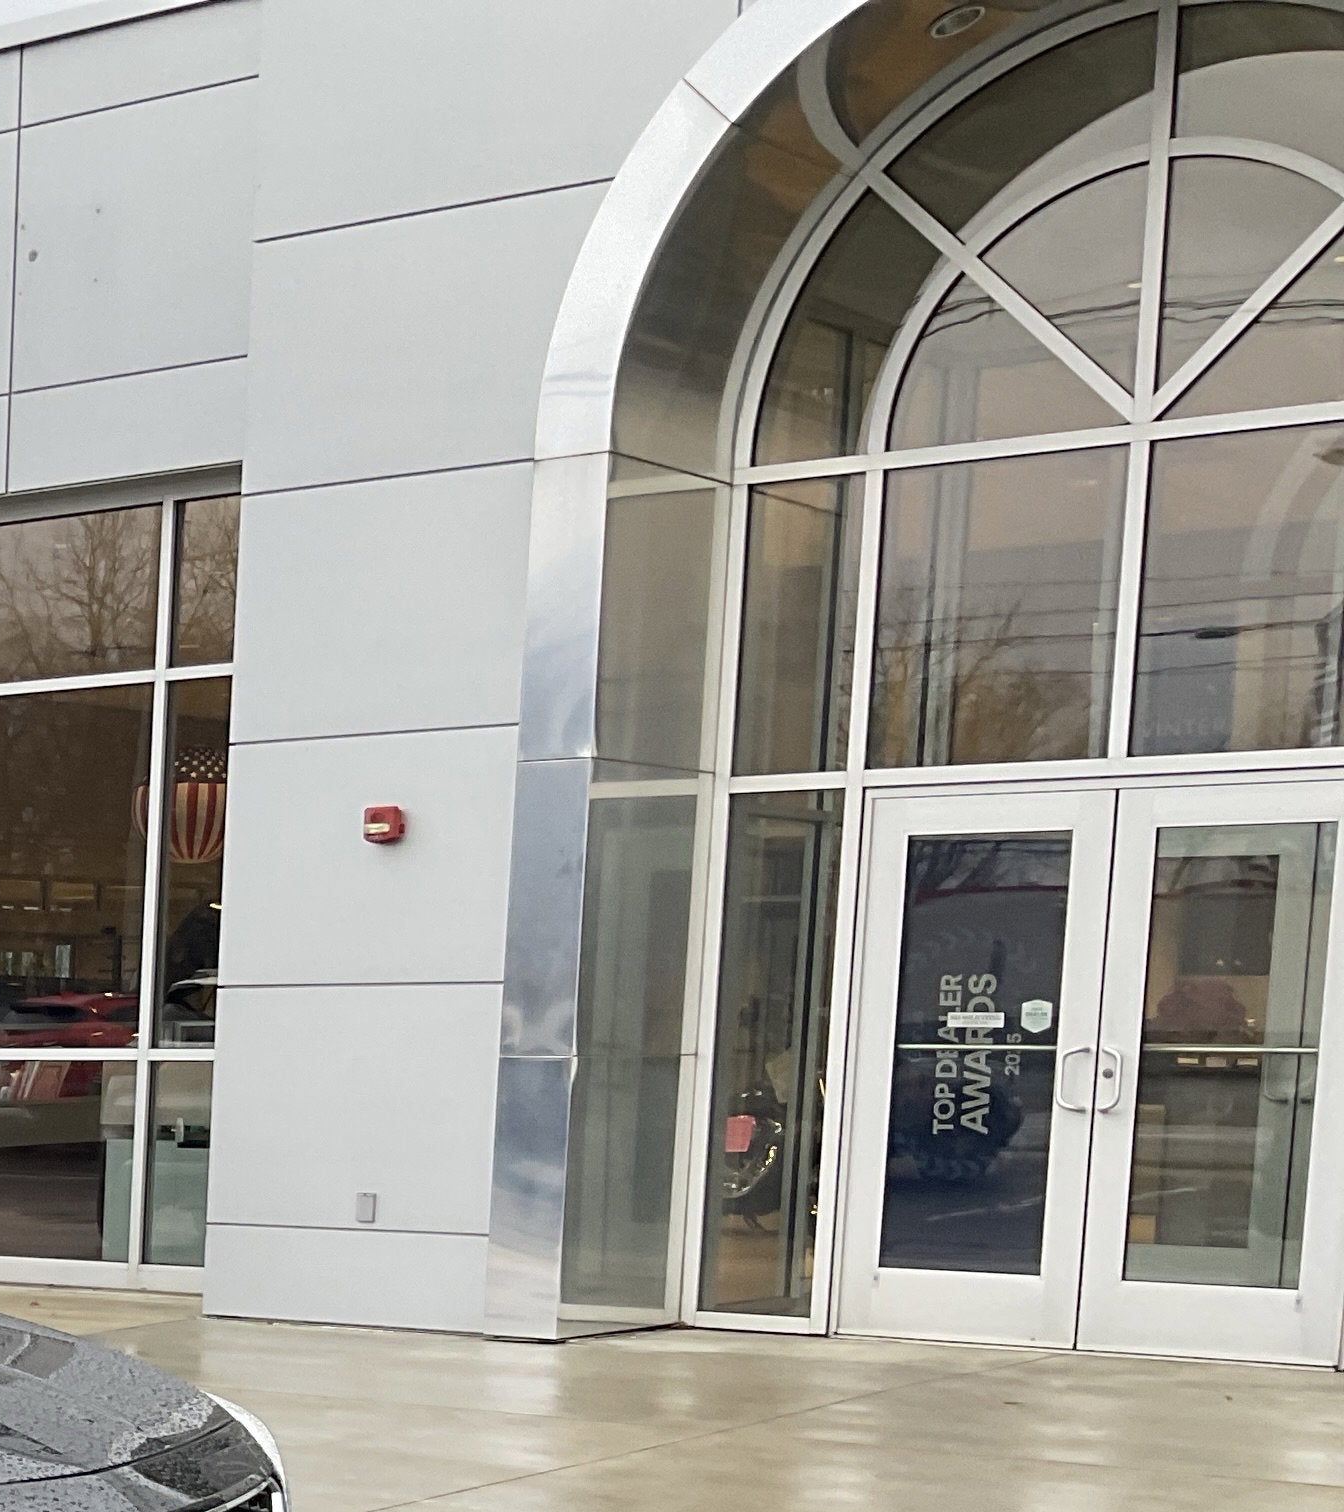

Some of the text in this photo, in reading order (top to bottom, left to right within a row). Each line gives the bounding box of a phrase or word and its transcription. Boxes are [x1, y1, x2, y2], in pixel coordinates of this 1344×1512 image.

[960, 973, 998, 1135] AWARDS
[1004, 1032, 1022, 1076] 205
[932, 1083, 956, 1135] TOP
